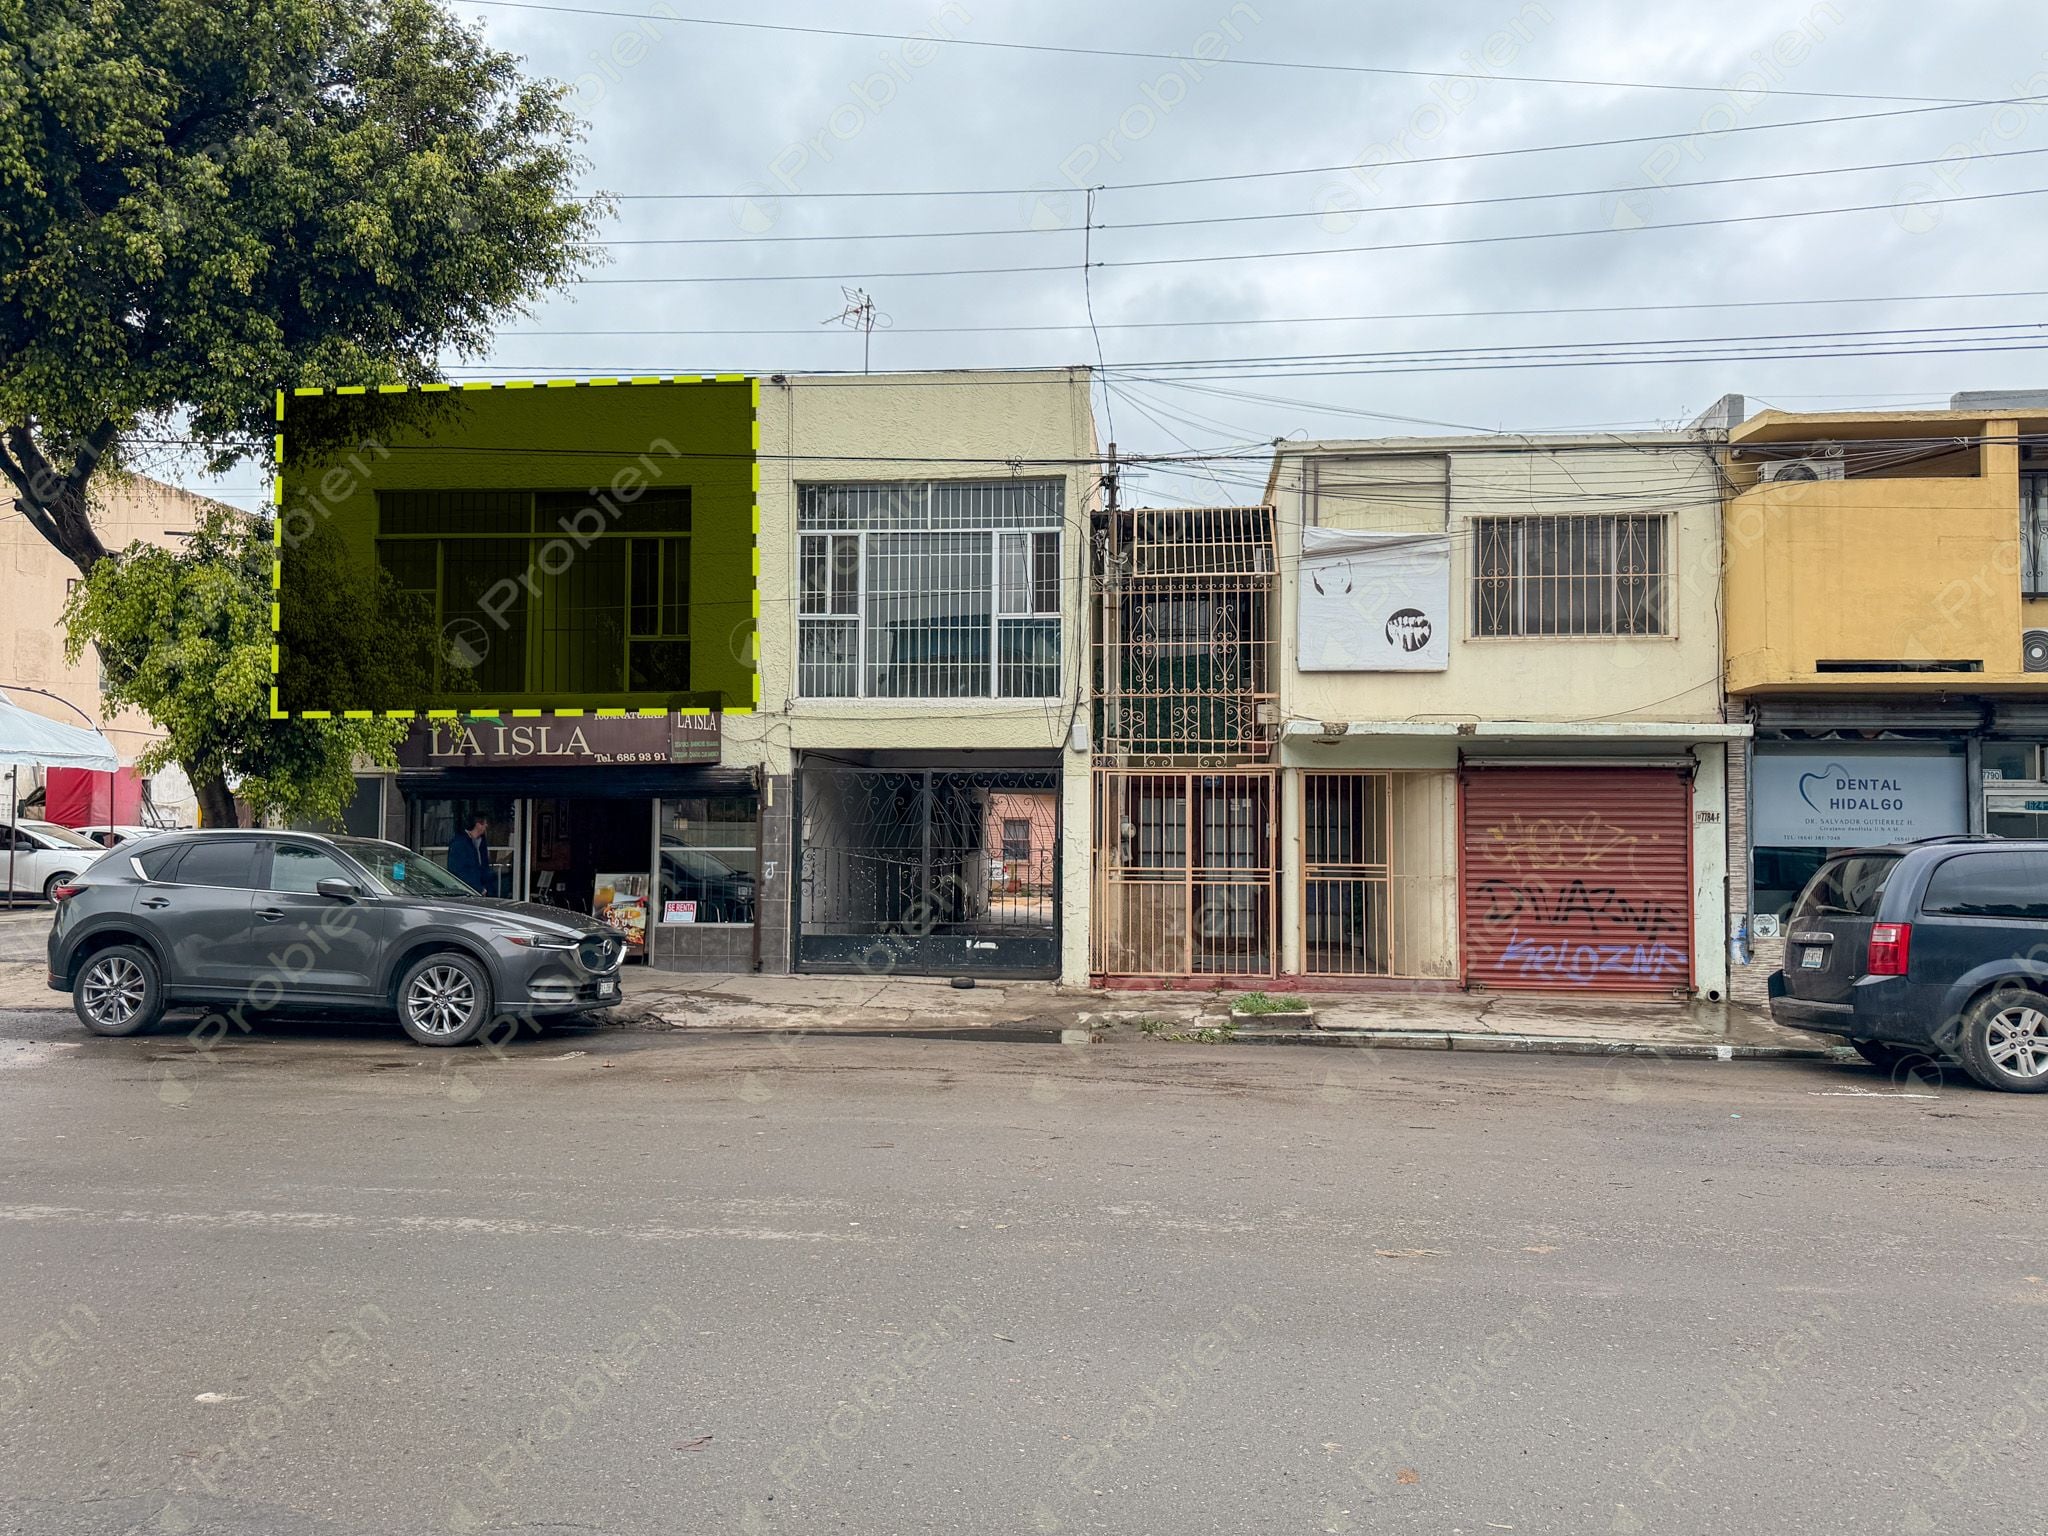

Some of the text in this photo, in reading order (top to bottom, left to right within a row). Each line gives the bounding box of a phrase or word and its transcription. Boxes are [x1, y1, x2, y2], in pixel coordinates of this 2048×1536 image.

[677, 712, 717, 731] LA ISLA
[428, 726, 594, 756] LA ISLA
[594, 753, 614, 763] Tel.
[616, 753, 636, 762] 685
[638, 752, 652, 762] 93
[653, 752, 667, 761] 91
[1836, 779, 1902, 791] DENTAL
[1830, 798, 1904, 811] HIDALGO
[668, 903, 694, 912] SE RENTA
